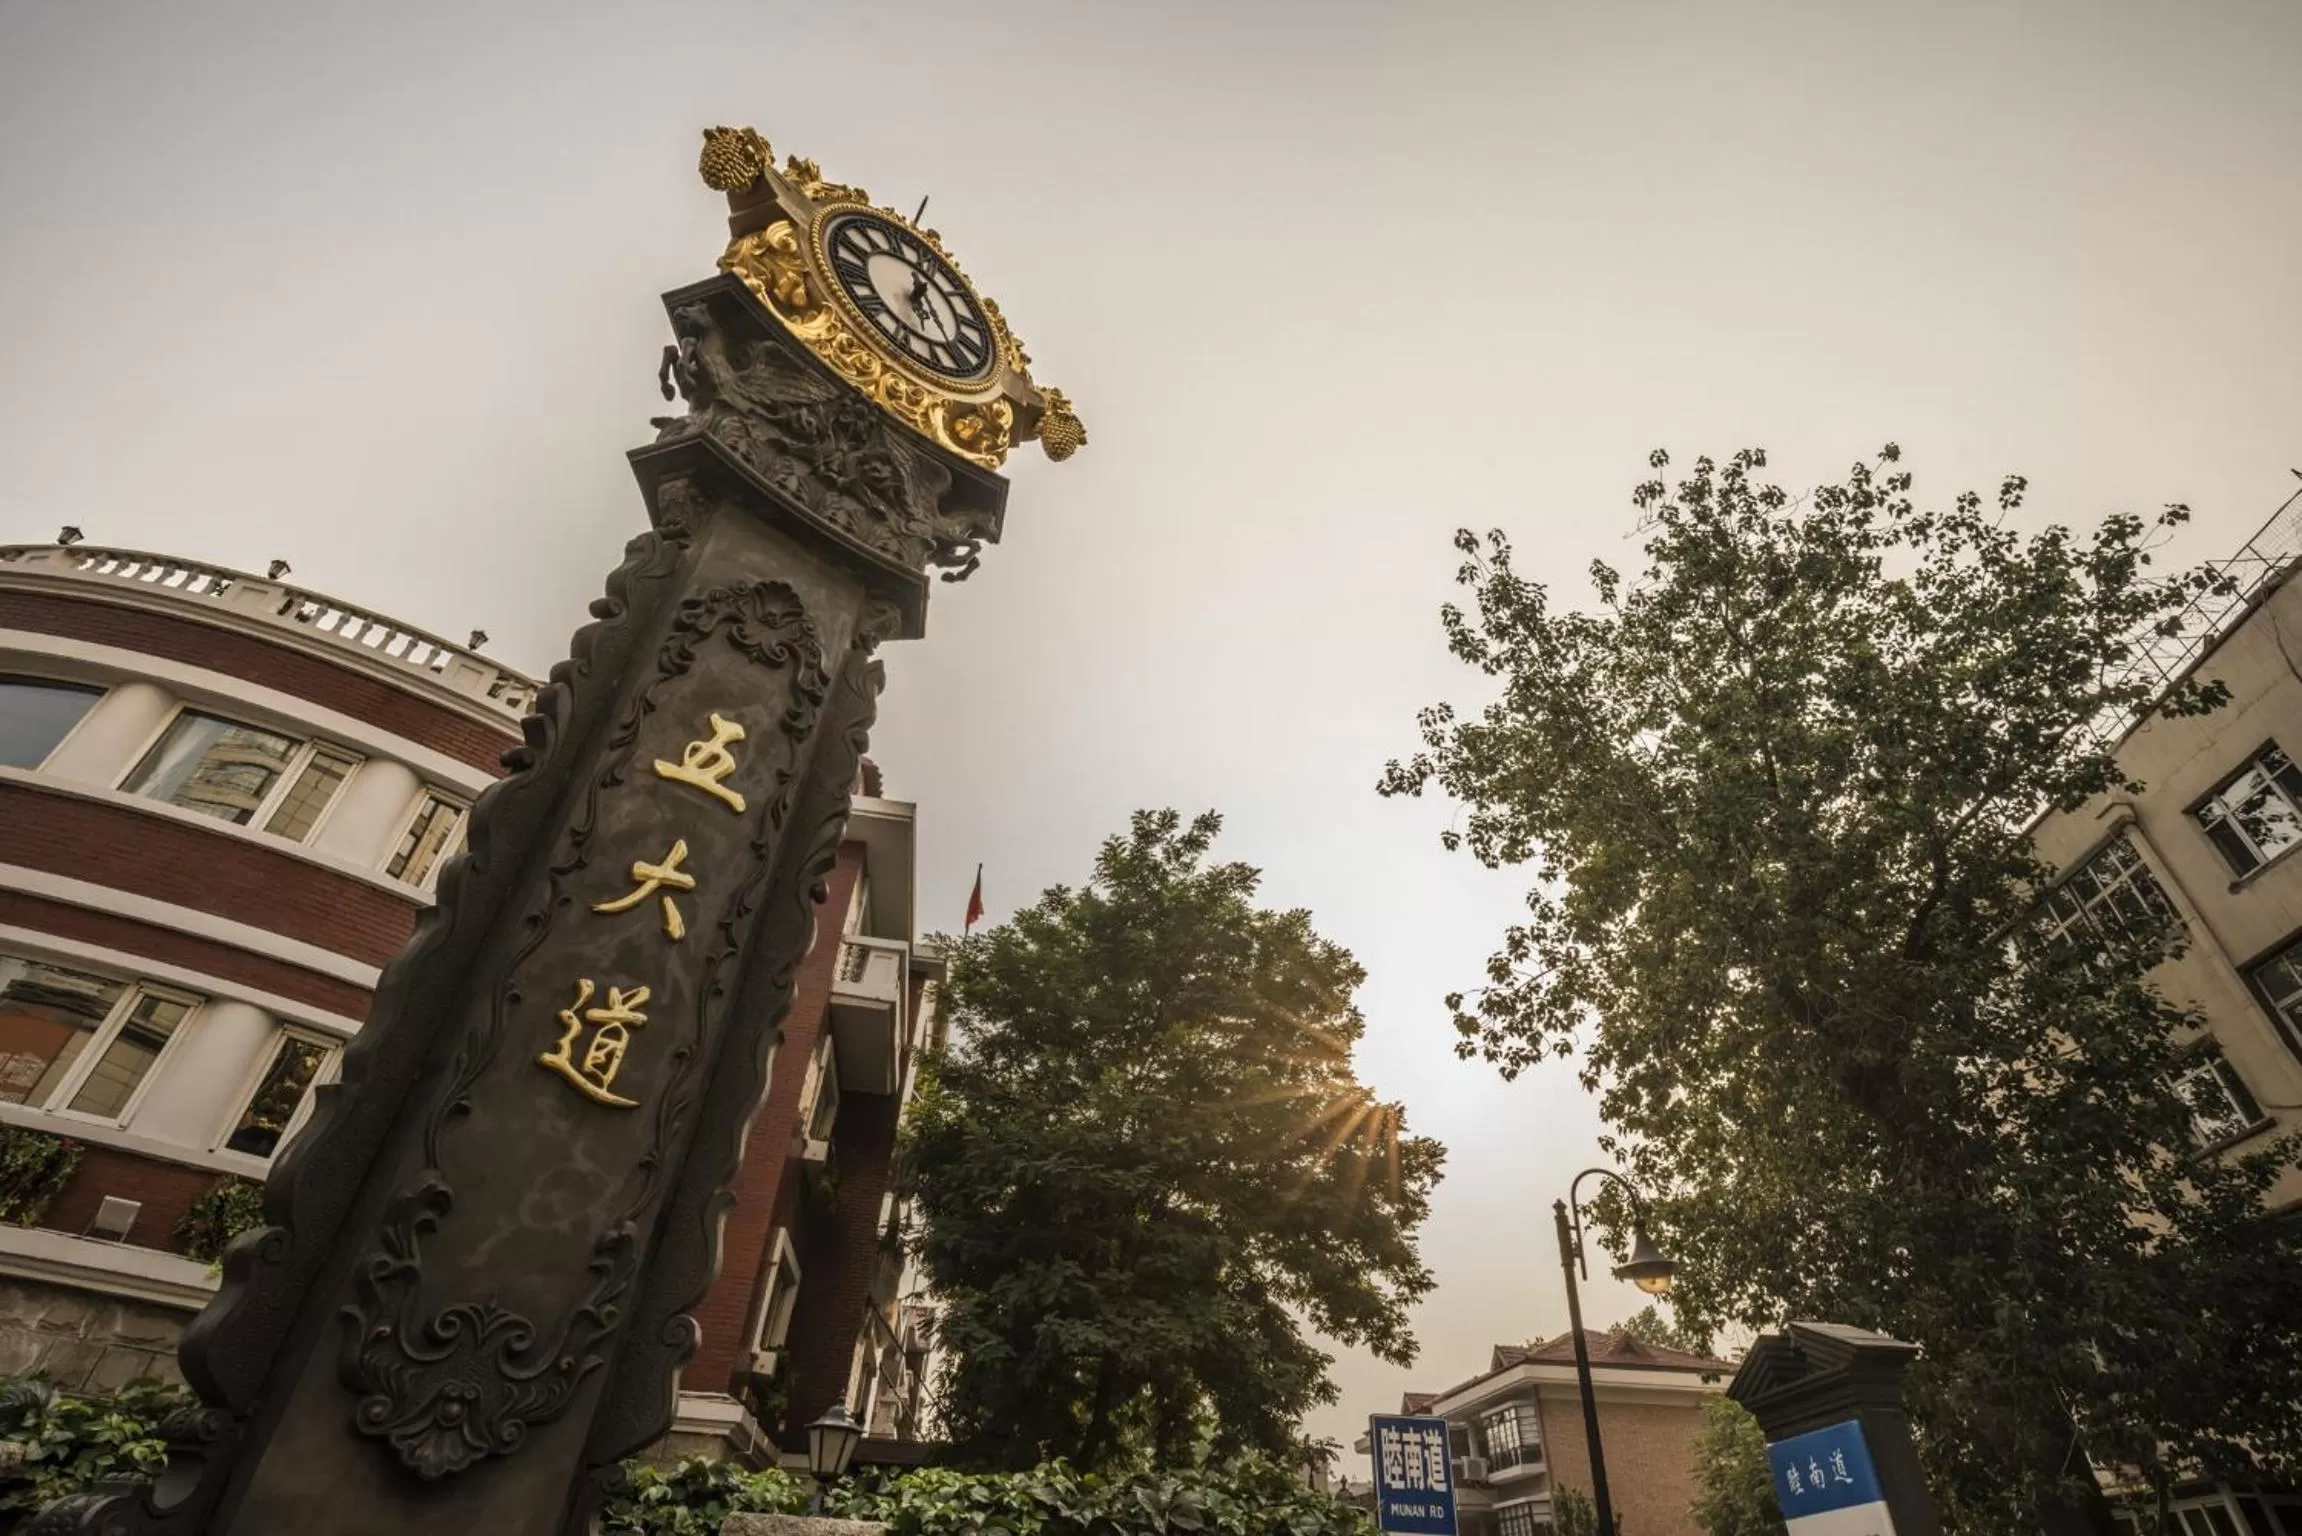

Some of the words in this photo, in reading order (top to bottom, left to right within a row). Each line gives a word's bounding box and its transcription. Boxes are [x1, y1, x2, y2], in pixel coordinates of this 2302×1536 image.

[539, 712, 747, 1109] 五大道
[1381, 1425, 1447, 1492] 睦南道
[1391, 1503, 1425, 1517] MUNAN
[1430, 1505, 1444, 1518] RD
